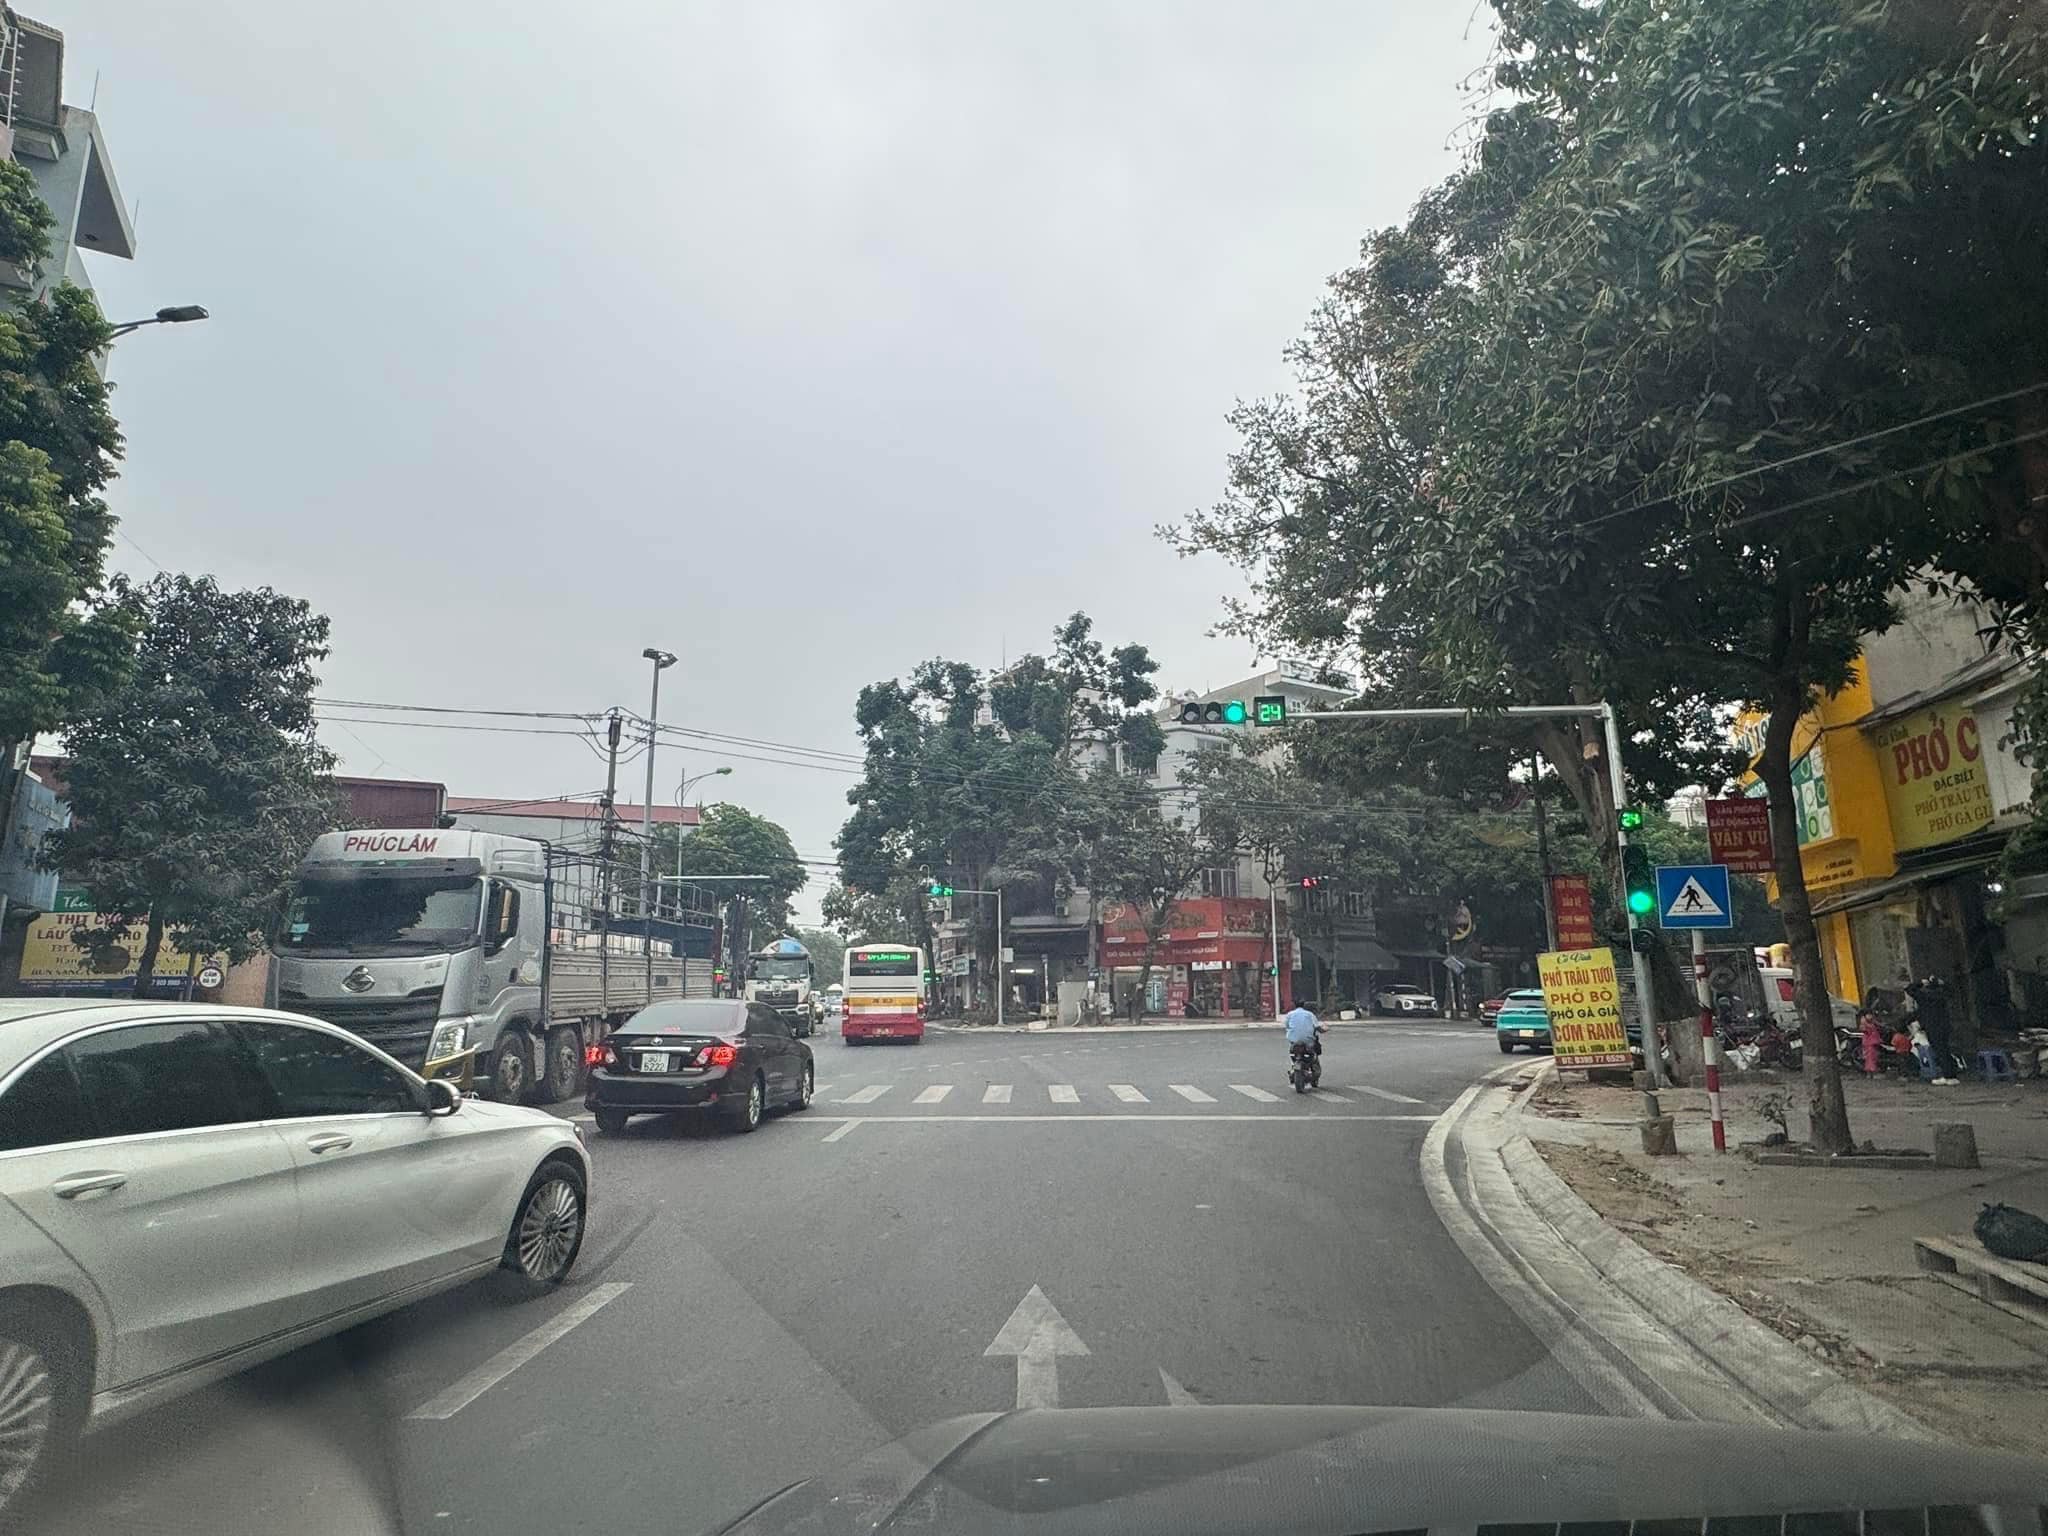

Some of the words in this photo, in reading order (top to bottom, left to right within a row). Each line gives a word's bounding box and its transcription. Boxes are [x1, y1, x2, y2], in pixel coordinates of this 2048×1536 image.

[1260, 704, 1281, 721] 24
[1893, 712, 1950, 785] PHỞ
[344, 832, 397, 852] PHÚC
[398, 833, 438, 852] LÂM
[1542, 966, 1563, 987] PHỞ
[1564, 967, 1590, 985] TRÂU
[1591, 966, 1614, 984] TƯƠI
[1551, 988, 1584, 1005] PHỞ
[1590, 987, 1612, 1002] BÒ
[1551, 1007, 1574, 1020] PHỞ
[1577, 1006, 1595, 1018] GÀ
[1554, 1022, 1584, 1042] CƠM
[1587, 1021, 1625, 1041] RANG
